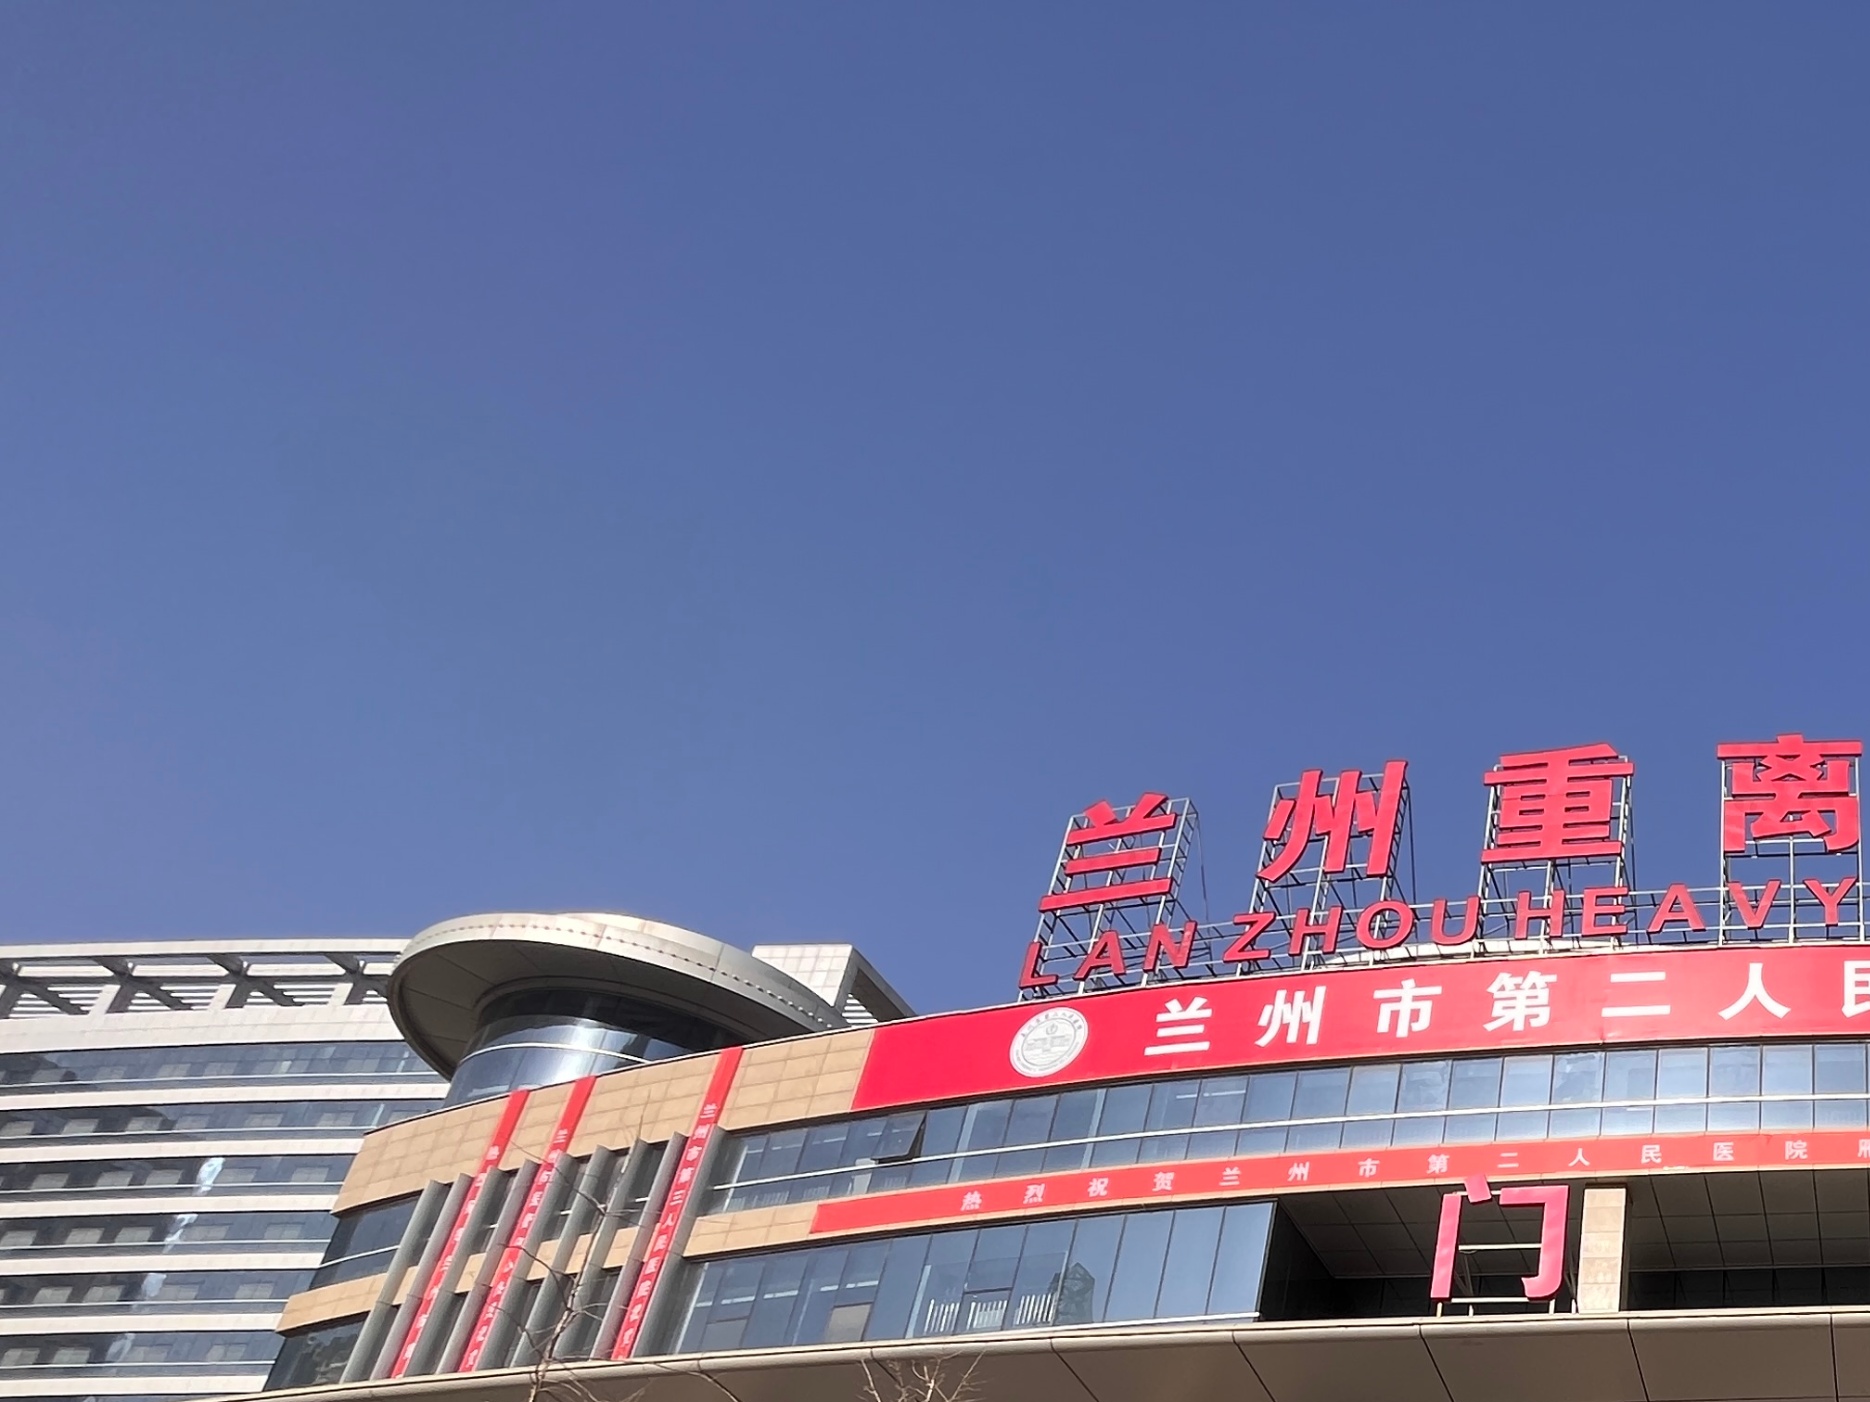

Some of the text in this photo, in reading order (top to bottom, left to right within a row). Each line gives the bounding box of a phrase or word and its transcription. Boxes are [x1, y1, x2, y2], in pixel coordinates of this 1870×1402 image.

[1019, 920, 1198, 989] LAN
[1223, 894, 1481, 963] ZHOU
[1514, 876, 1859, 940] HEAVY
